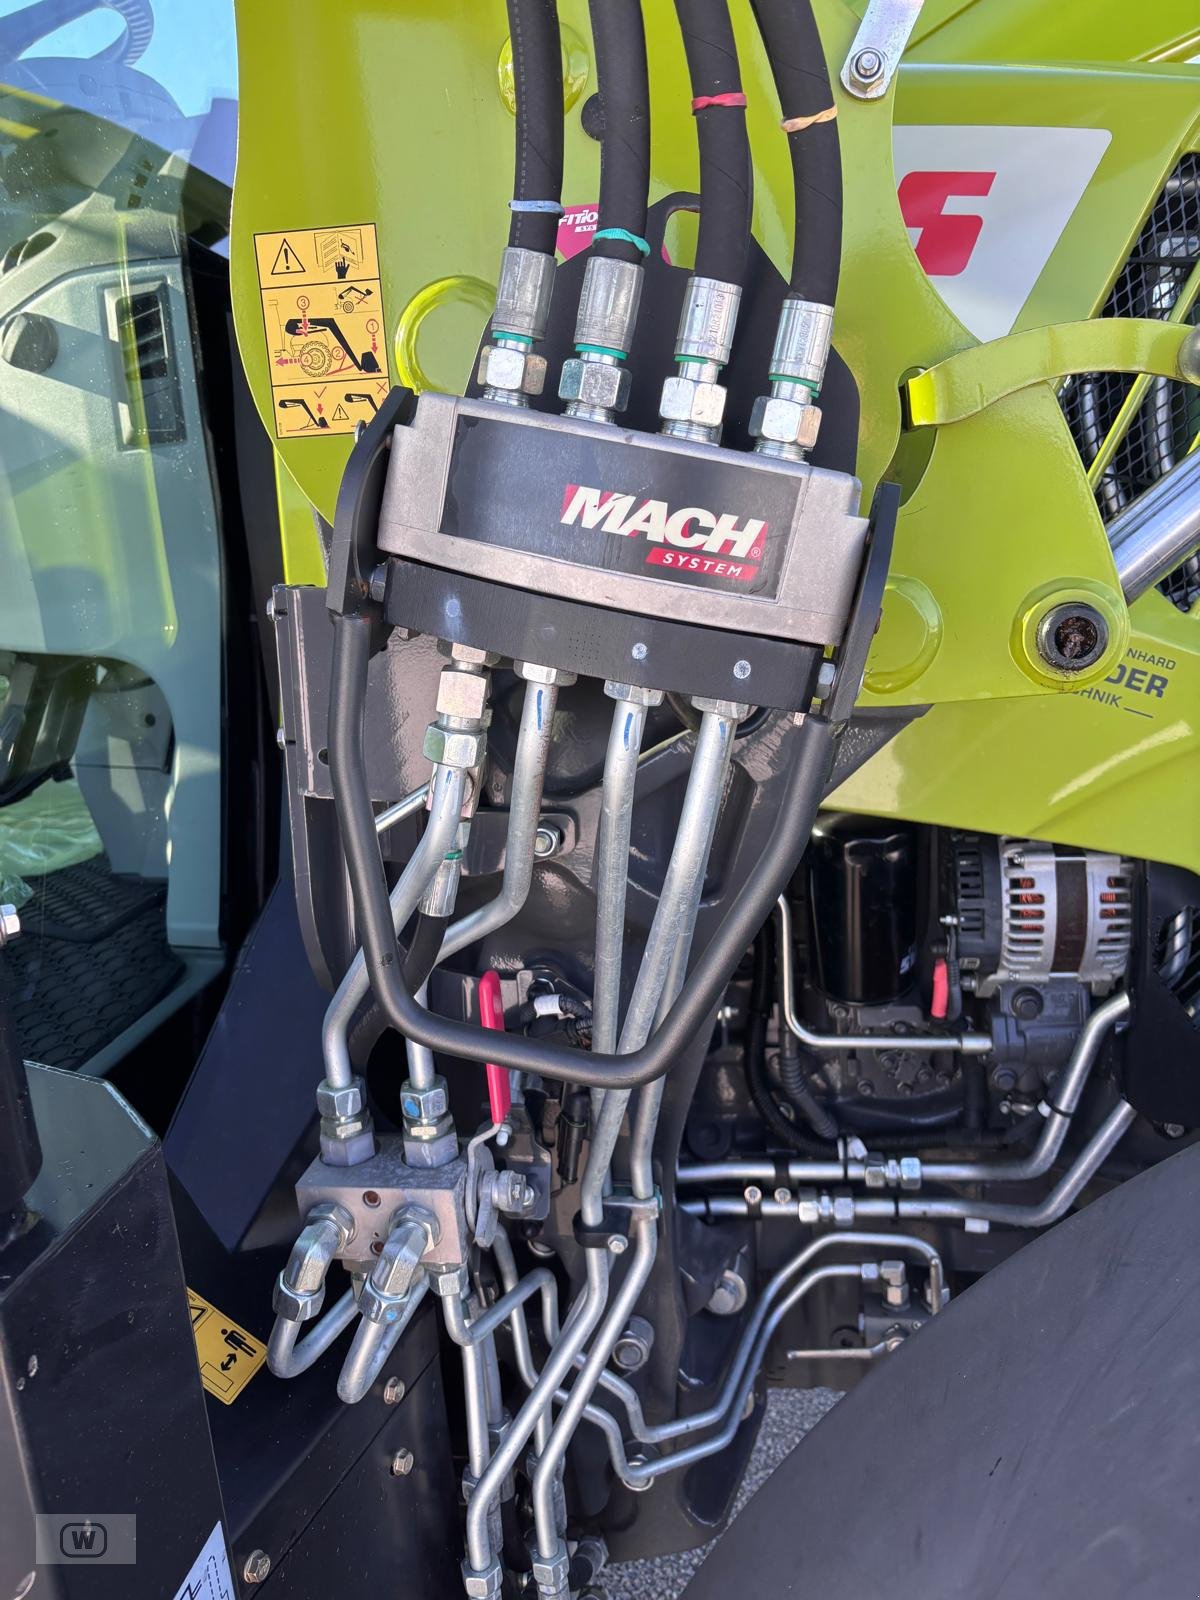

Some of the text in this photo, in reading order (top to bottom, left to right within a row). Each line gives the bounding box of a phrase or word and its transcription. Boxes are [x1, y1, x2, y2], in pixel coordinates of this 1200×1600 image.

[560, 486, 766, 558] MACH
[662, 553, 743, 577] SYSTEM
[1126, 647, 1177, 671] NHARD
[1072, 687, 1123, 708] HNIK
